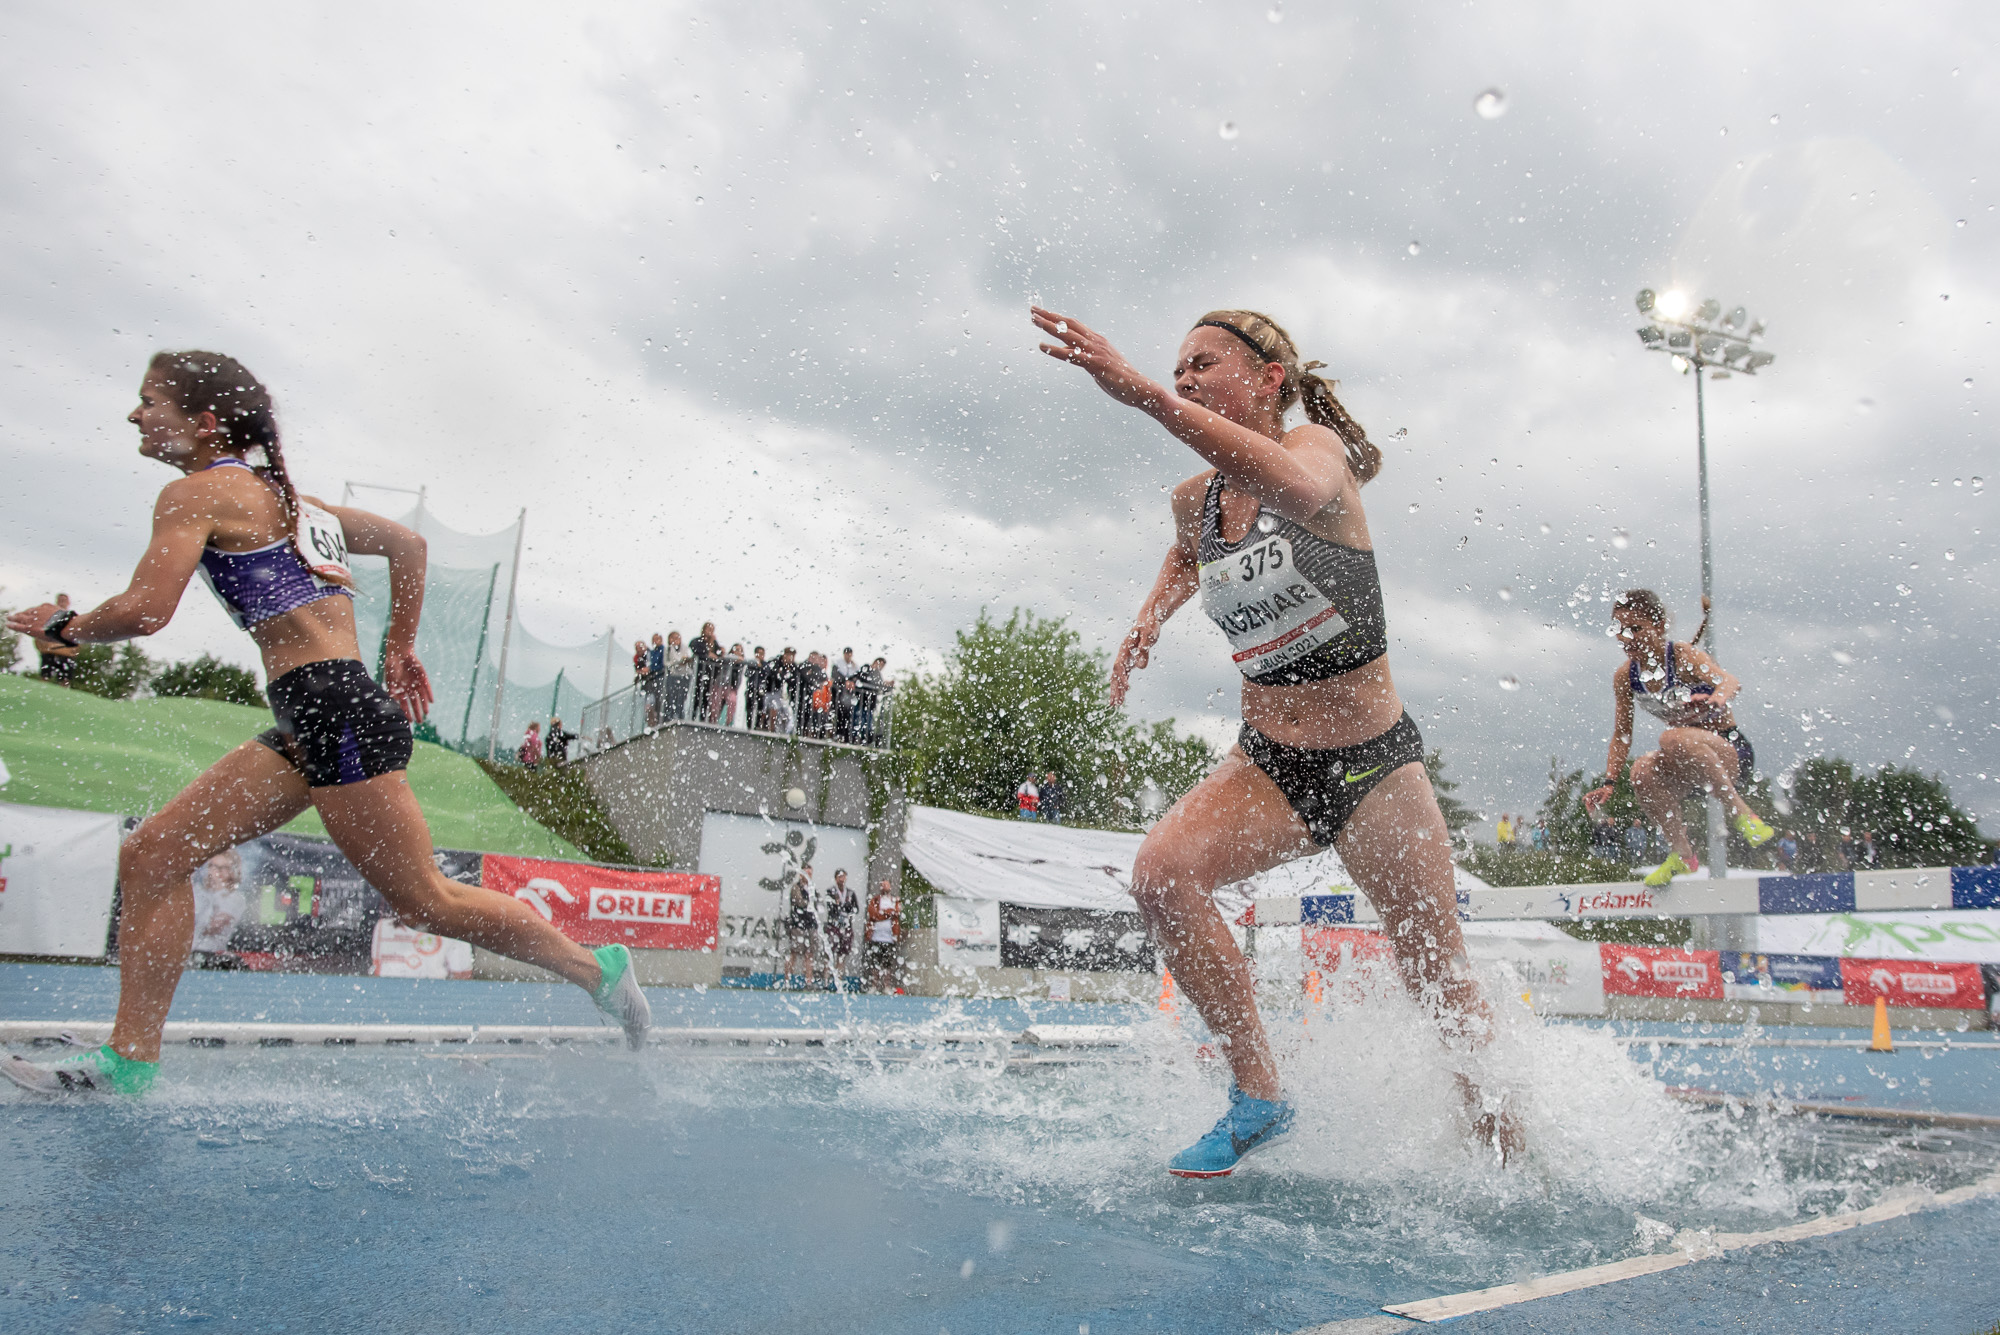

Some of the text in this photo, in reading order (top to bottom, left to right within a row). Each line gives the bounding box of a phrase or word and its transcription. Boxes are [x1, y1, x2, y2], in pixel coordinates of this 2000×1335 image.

[1239, 540, 1284, 582] 375
[1214, 583, 1317, 638] KUŹNIAR
[1253, 651, 1290, 673] UBLIN
[1288, 634, 1320, 658] 2021
[596, 894, 685, 919] ORLEN
[1657, 965, 1704, 979] ORLEN
[1905, 975, 1953, 990] ORLEN
